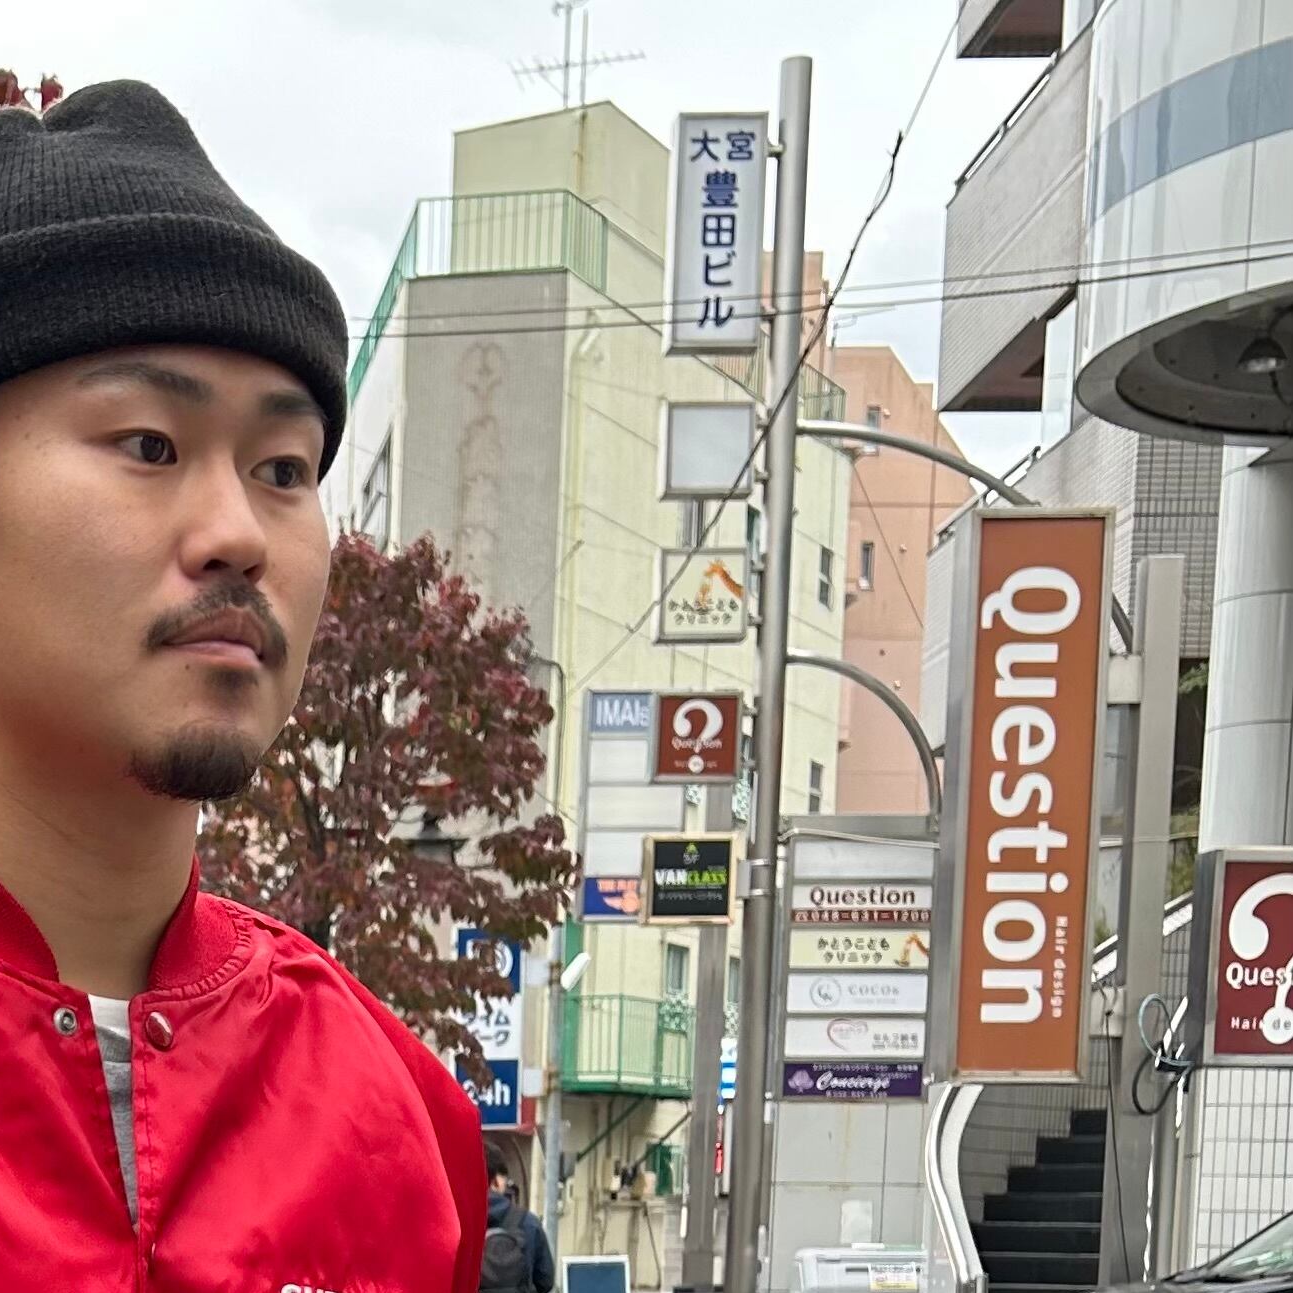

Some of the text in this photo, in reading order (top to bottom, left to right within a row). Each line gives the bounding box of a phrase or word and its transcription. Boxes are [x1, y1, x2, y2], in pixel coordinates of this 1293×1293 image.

[980, 566, 1082, 1024] Question
[810, 886, 916, 907] Question
[1226, 962, 1293, 989] Ques
